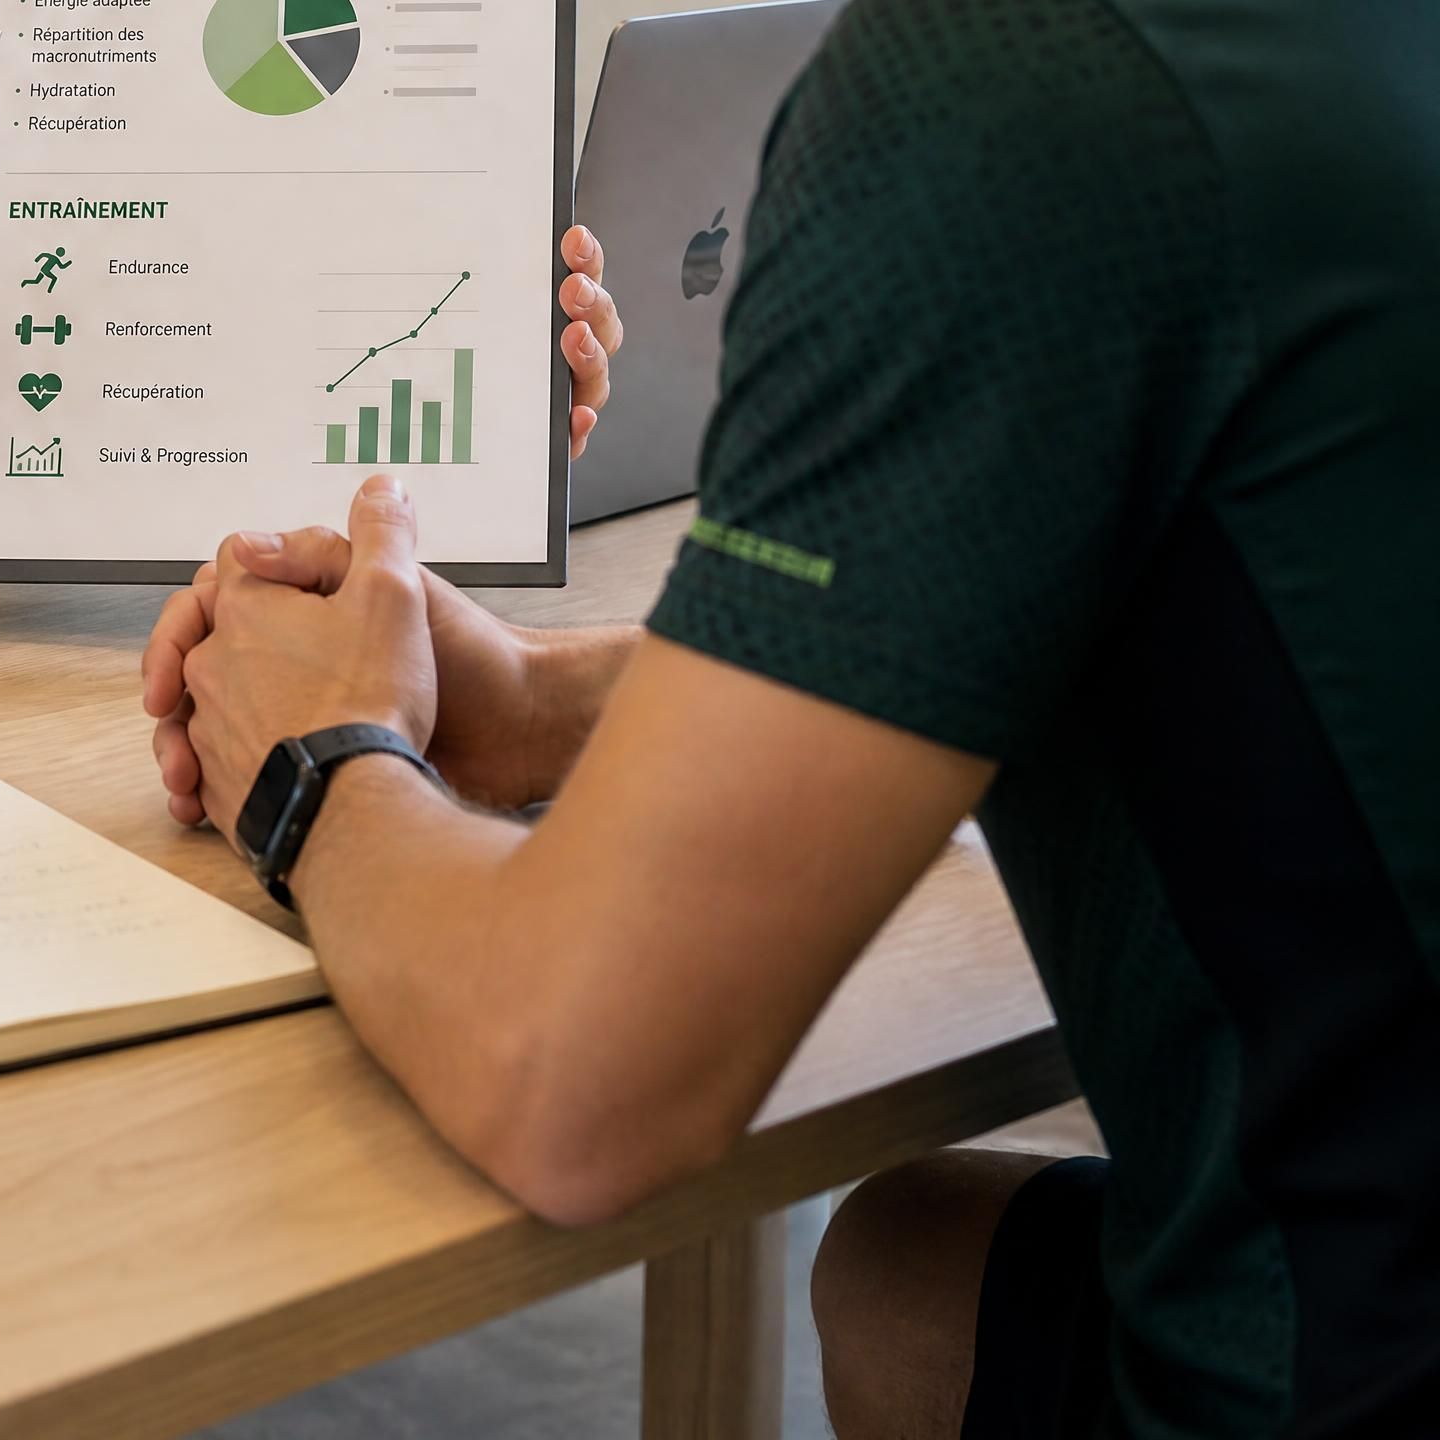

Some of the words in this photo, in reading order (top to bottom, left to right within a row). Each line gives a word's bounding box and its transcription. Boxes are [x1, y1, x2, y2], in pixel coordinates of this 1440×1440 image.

[33, 27, 114, 45] Répartition
[118, 26, 144, 41] des
[32, 48, 157, 63] macronutriments
[30, 82, 116, 101] Hydratation
[28, 115, 126, 134] Récupération
[9, 196, 169, 219] ENTRAÎNEMENT
[109, 259, 189, 275] Endurance
[105, 321, 212, 337] Renforcement
[102, 383, 204, 402] Récupération
[99, 447, 136, 463] Suivi
[140, 448, 152, 463] &
[157, 447, 248, 467] Progression
